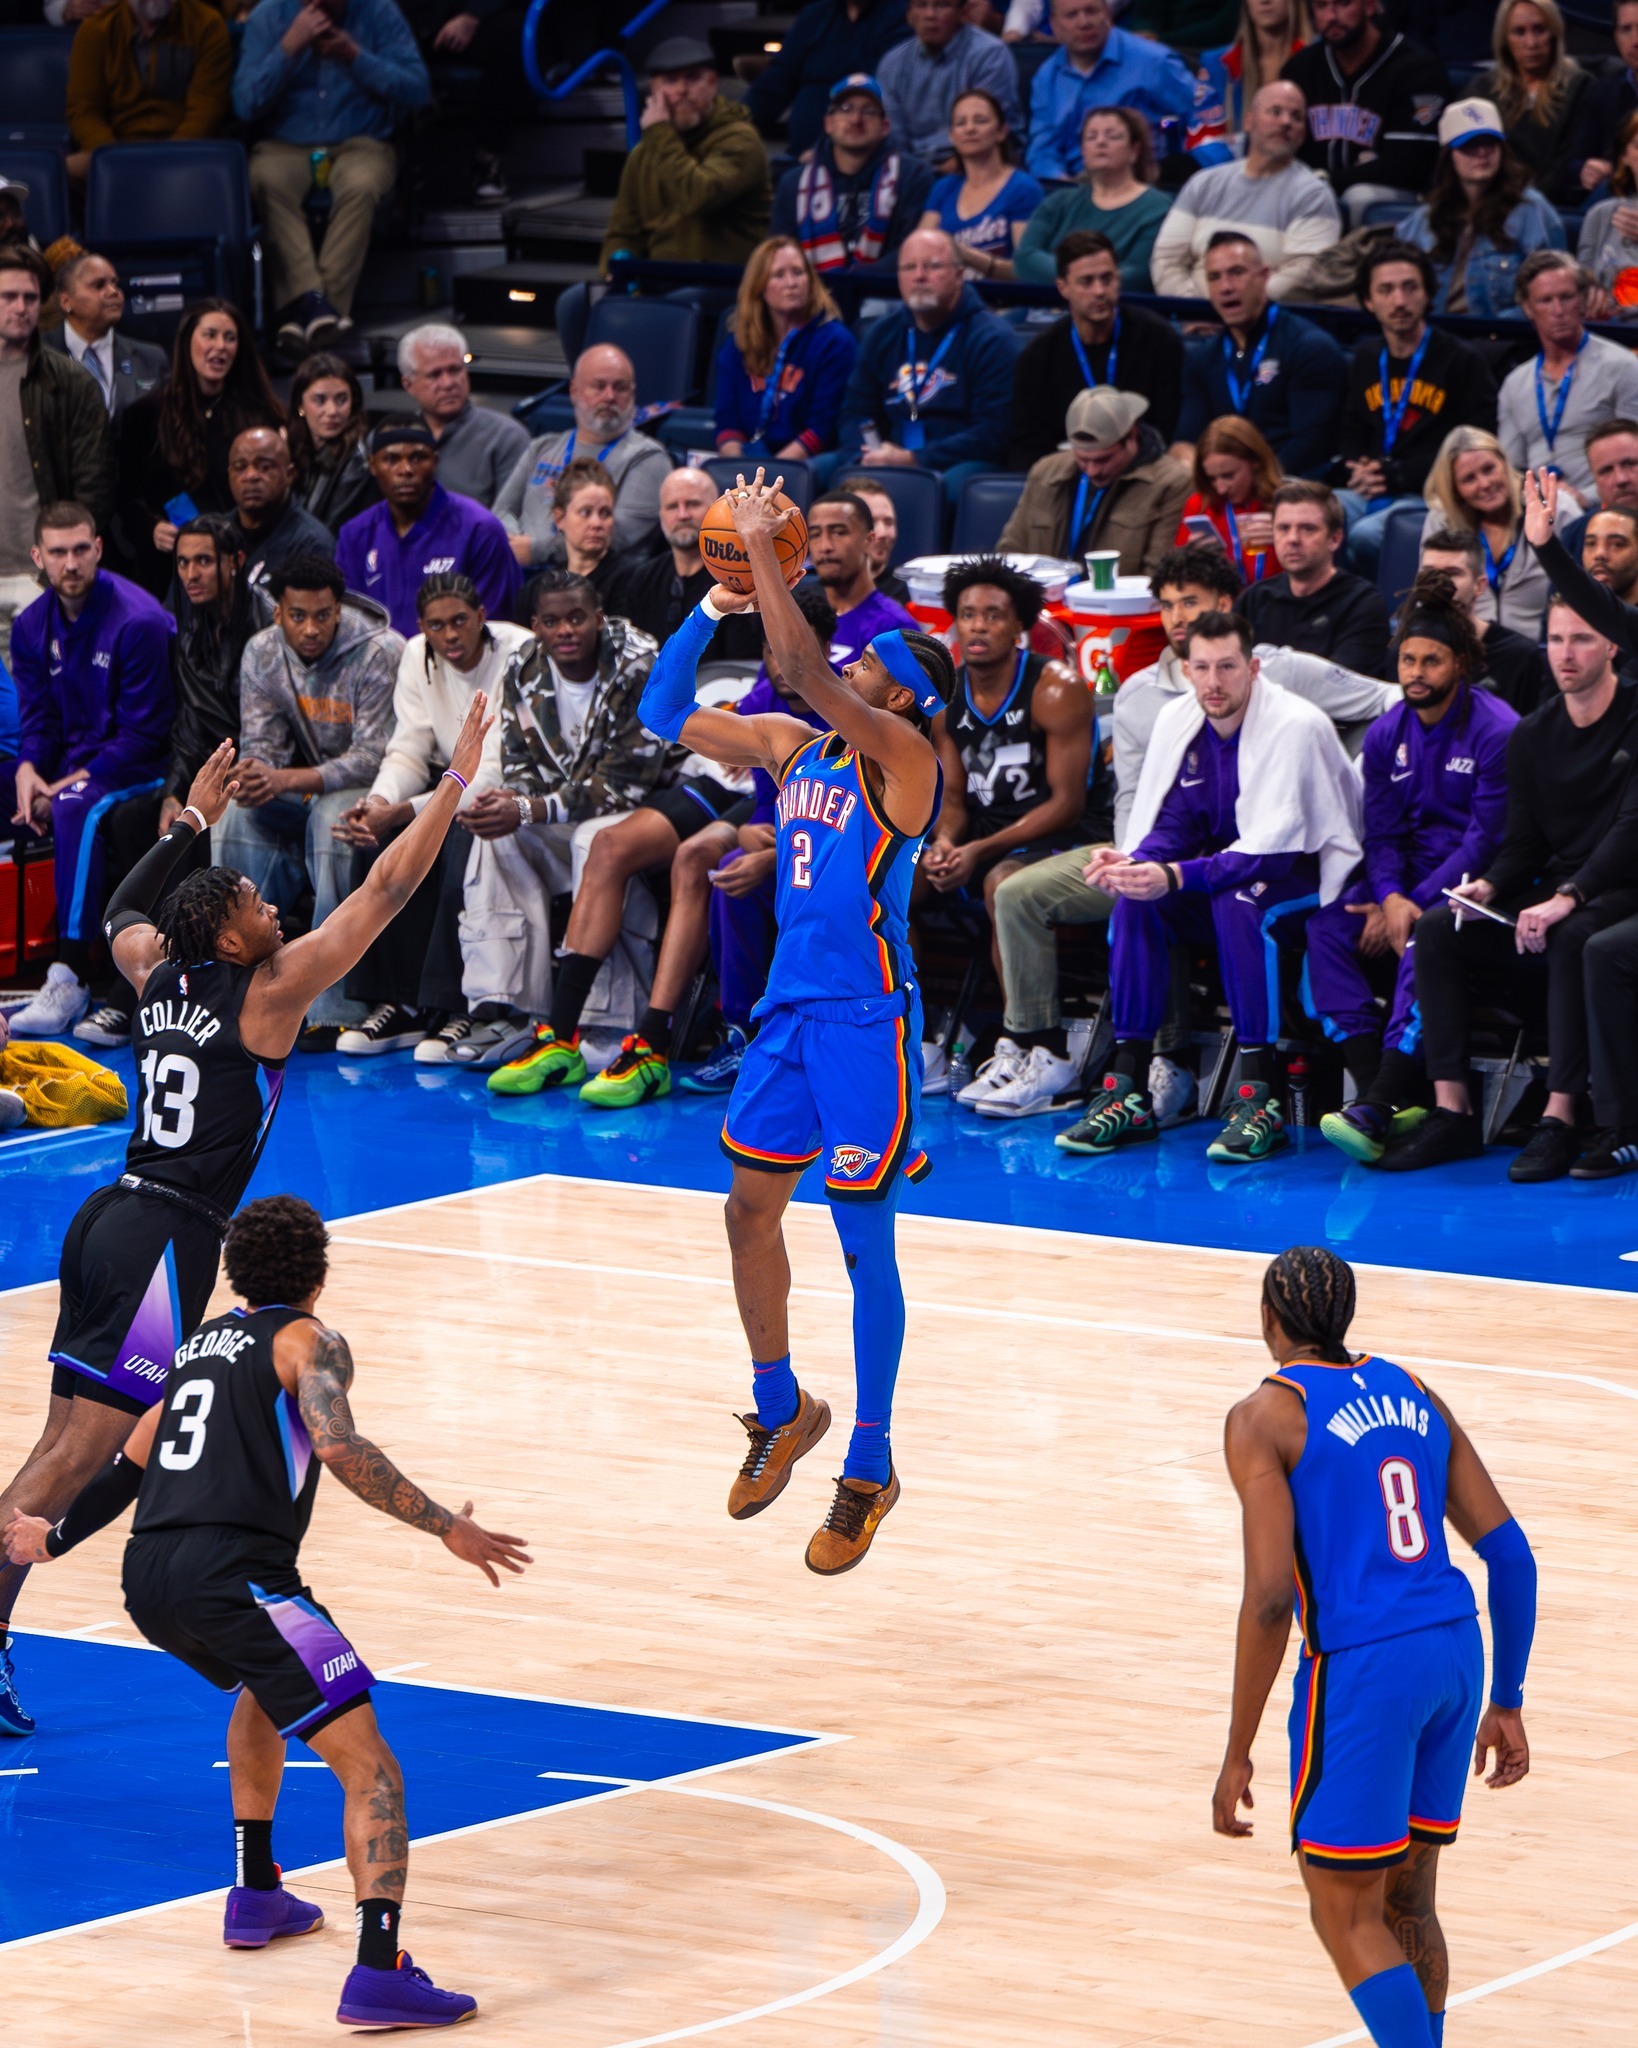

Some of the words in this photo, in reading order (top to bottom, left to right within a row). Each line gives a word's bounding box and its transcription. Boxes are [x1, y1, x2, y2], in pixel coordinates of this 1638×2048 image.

[423, 557, 455, 574] JAZZ
[704, 536, 750, 563] Wils
[1005, 766, 1037, 801] 2
[1445, 757, 1475, 774] JAZZ
[776, 778, 858, 834] THUNDER
[791, 830, 812, 889] 2
[139, 1000, 221, 1047] COLLIER
[141, 1049, 200, 1149] 13
[836, 1153, 862, 1168] OKC
[123, 1354, 169, 1384] UTAH
[174, 1328, 256, 1369] GEORGE
[159, 1379, 215, 1471] 3
[1326, 1395, 1429, 1447] WILLIAMS
[1378, 1456, 1429, 1563] 8
[323, 1651, 358, 1682] UTAH
